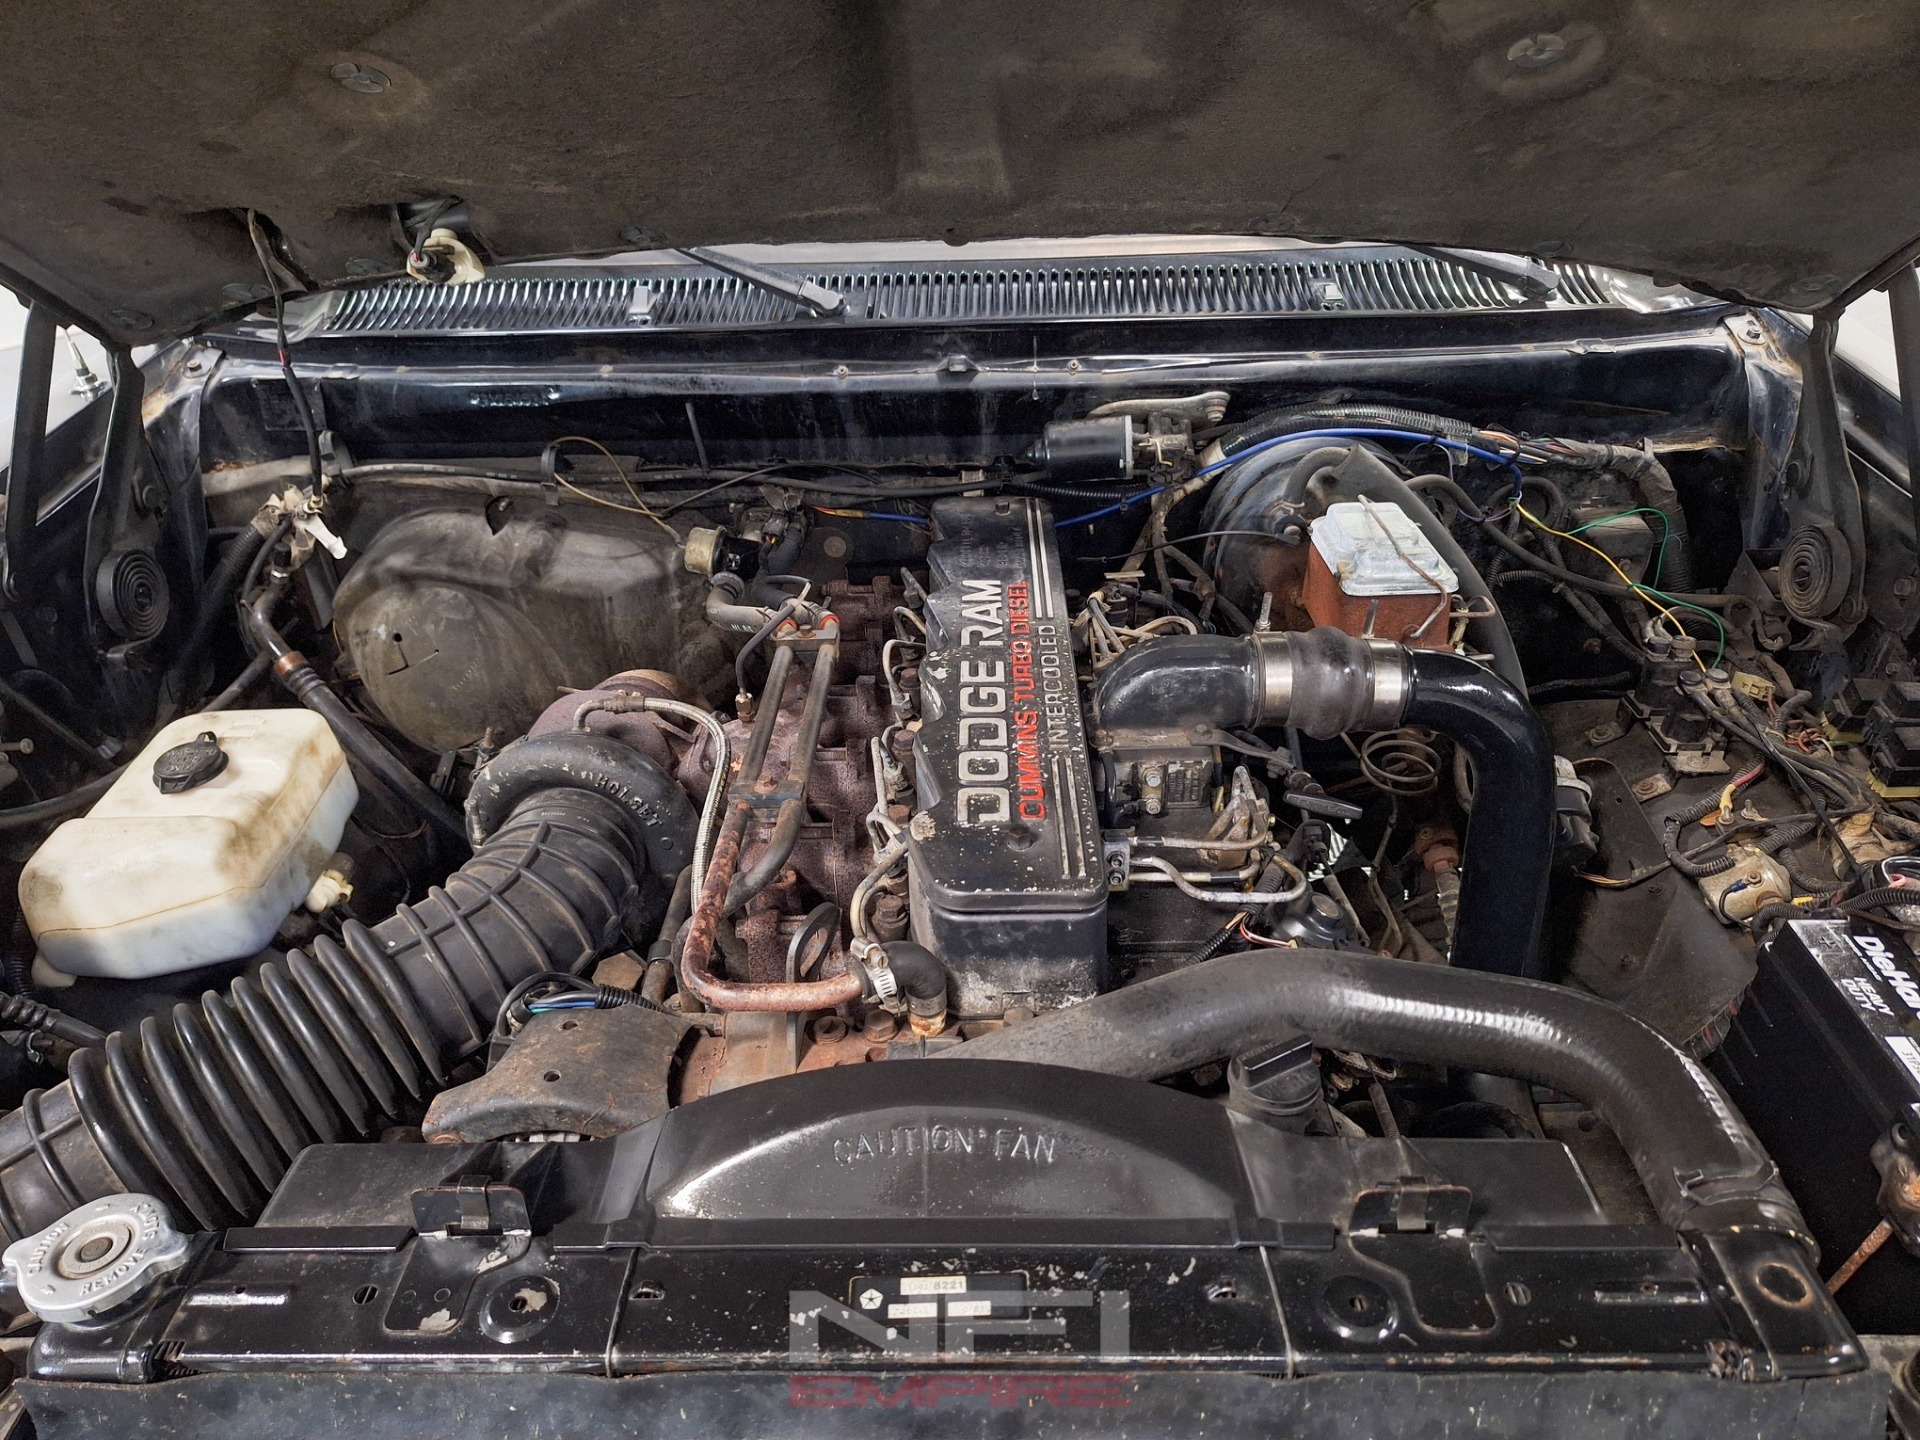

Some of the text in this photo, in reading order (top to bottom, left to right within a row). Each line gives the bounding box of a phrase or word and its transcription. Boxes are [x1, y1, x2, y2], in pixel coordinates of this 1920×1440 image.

[1008, 580, 1031, 635] DIESEL
[1010, 639, 1035, 704] TURBO
[1038, 625, 1071, 752] INTERCOOLED
[957, 580, 1010, 822] DODGE RAM
[1014, 710, 1046, 821] CUMMINS
[594, 772, 663, 827] HOLSET
[1840, 978, 1877, 1012] DUTY
[1853, 935, 1920, 1023] DieHar
[1853, 976, 1895, 1017] HEAVY
[833, 1123, 1056, 1165] CAUTION FAN
[27, 1221, 70, 1277] CAUTION
[79, 1247, 149, 1296] REMOVE
